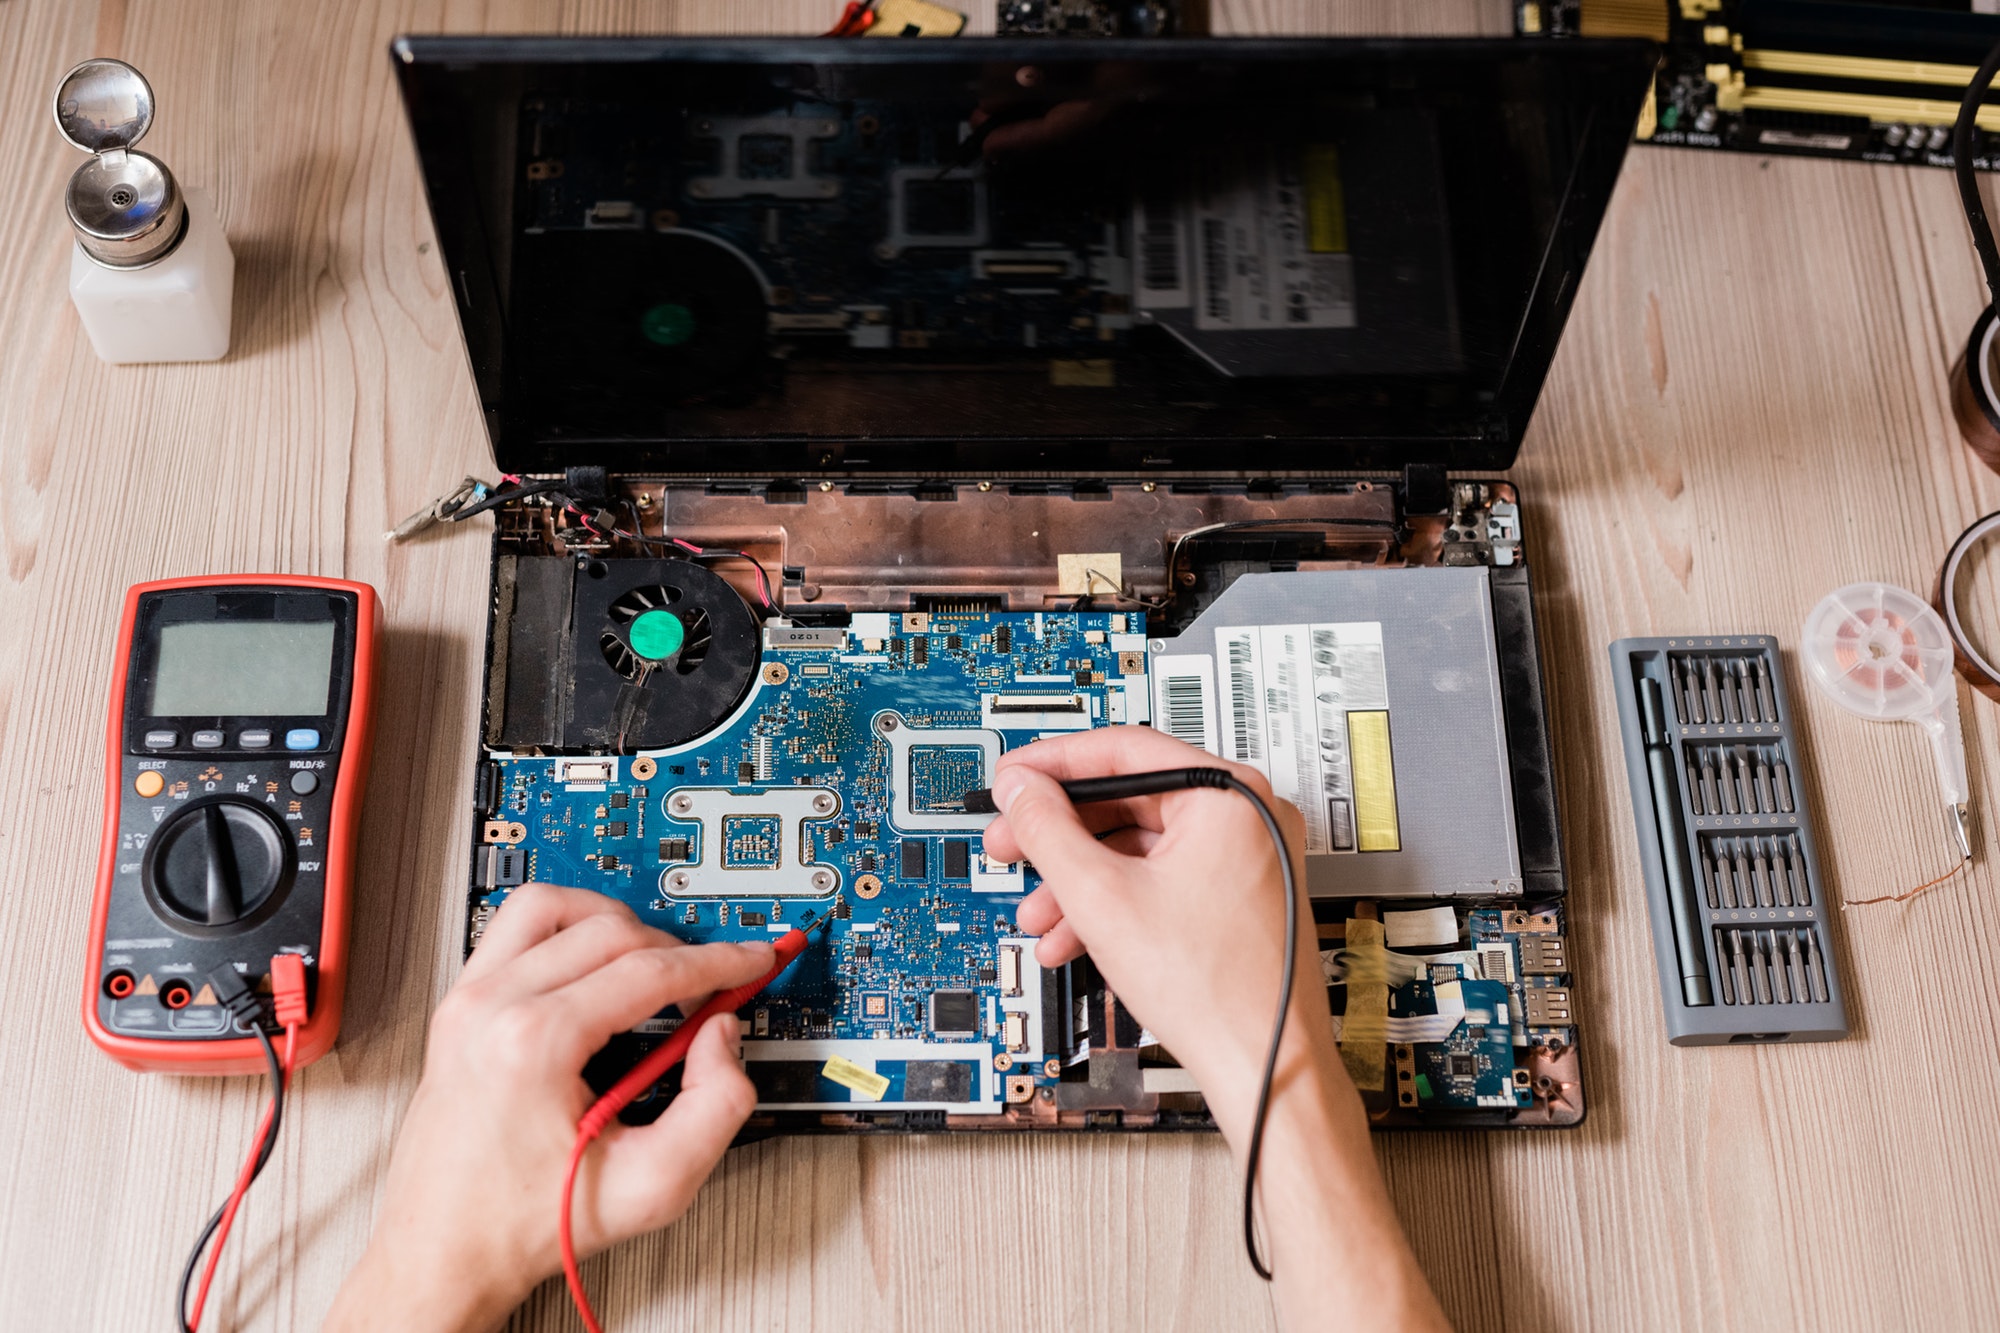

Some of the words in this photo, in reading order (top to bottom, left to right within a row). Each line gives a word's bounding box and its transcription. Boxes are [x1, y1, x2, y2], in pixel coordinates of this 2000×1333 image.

[1087, 619, 1103, 627] MIC
[1130, 612, 1139, 634] SPEAK
[138, 761, 168, 770] SELECT
[236, 782, 250, 793] Hz
[265, 793, 276, 803] A
[286, 811, 303, 820] mA
[298, 861, 321, 872] NCV
